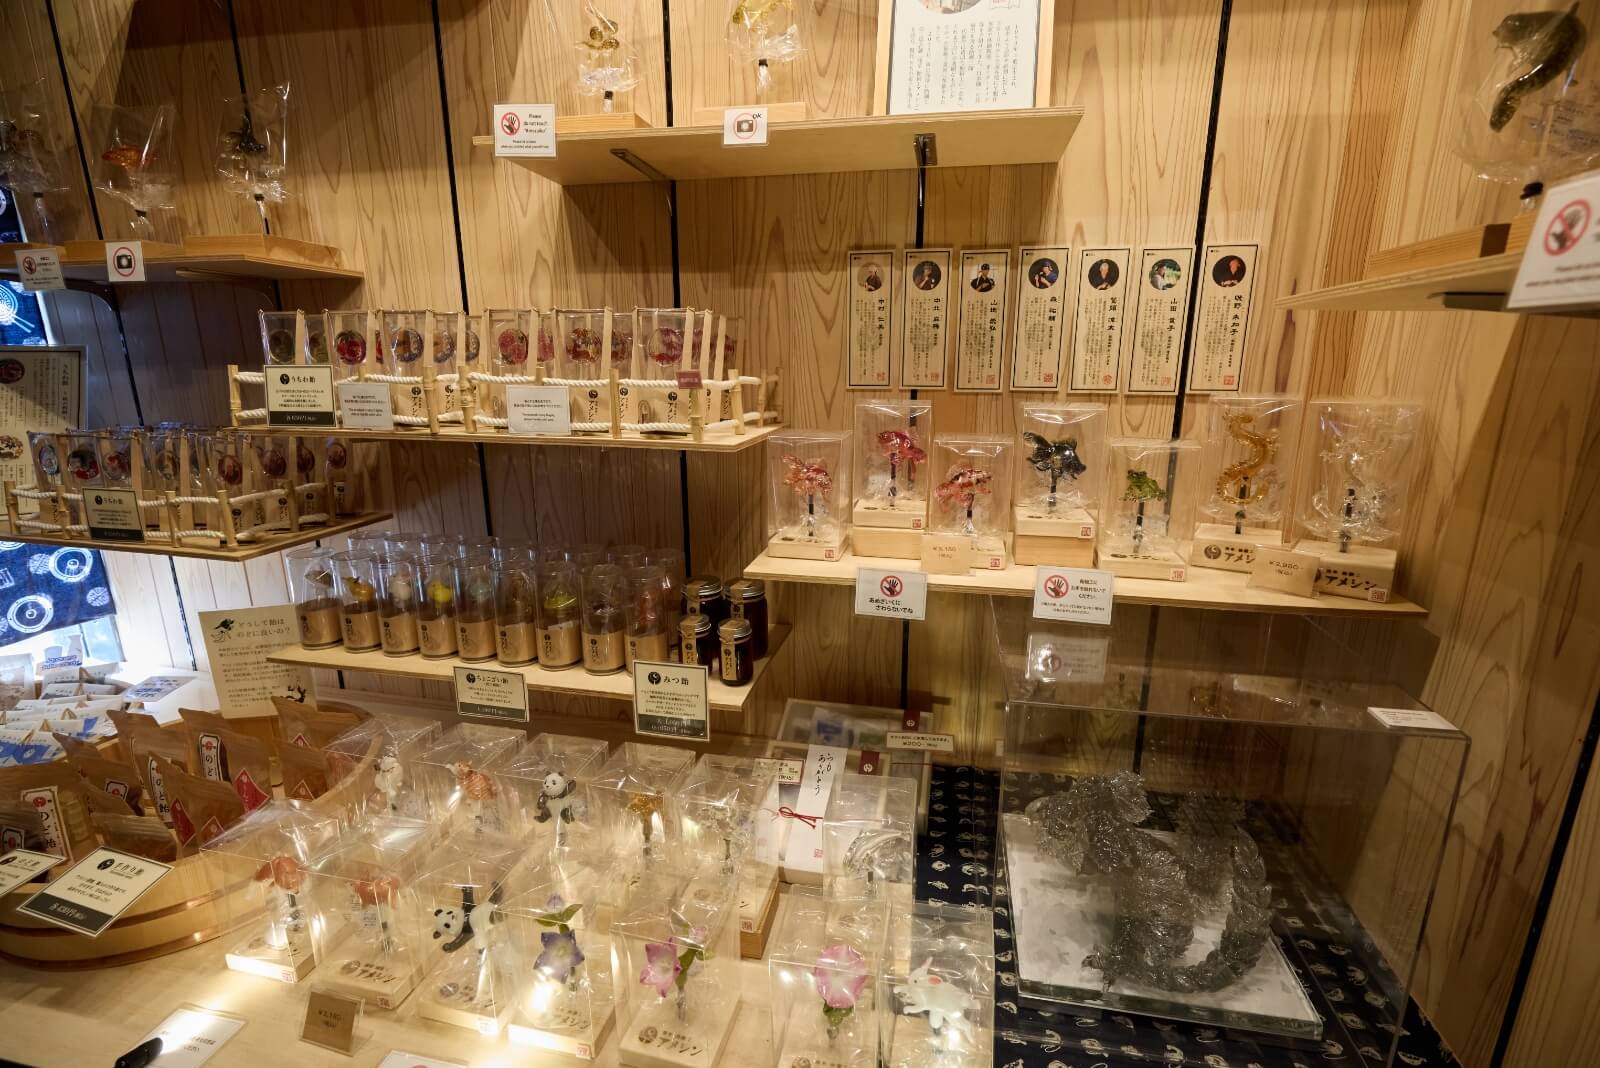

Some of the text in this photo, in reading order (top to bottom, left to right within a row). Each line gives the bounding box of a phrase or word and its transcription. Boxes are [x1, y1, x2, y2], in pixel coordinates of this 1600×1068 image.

[1224, 552, 1256, 564] アメシ
[1325, 575, 1377, 591] アメシン
